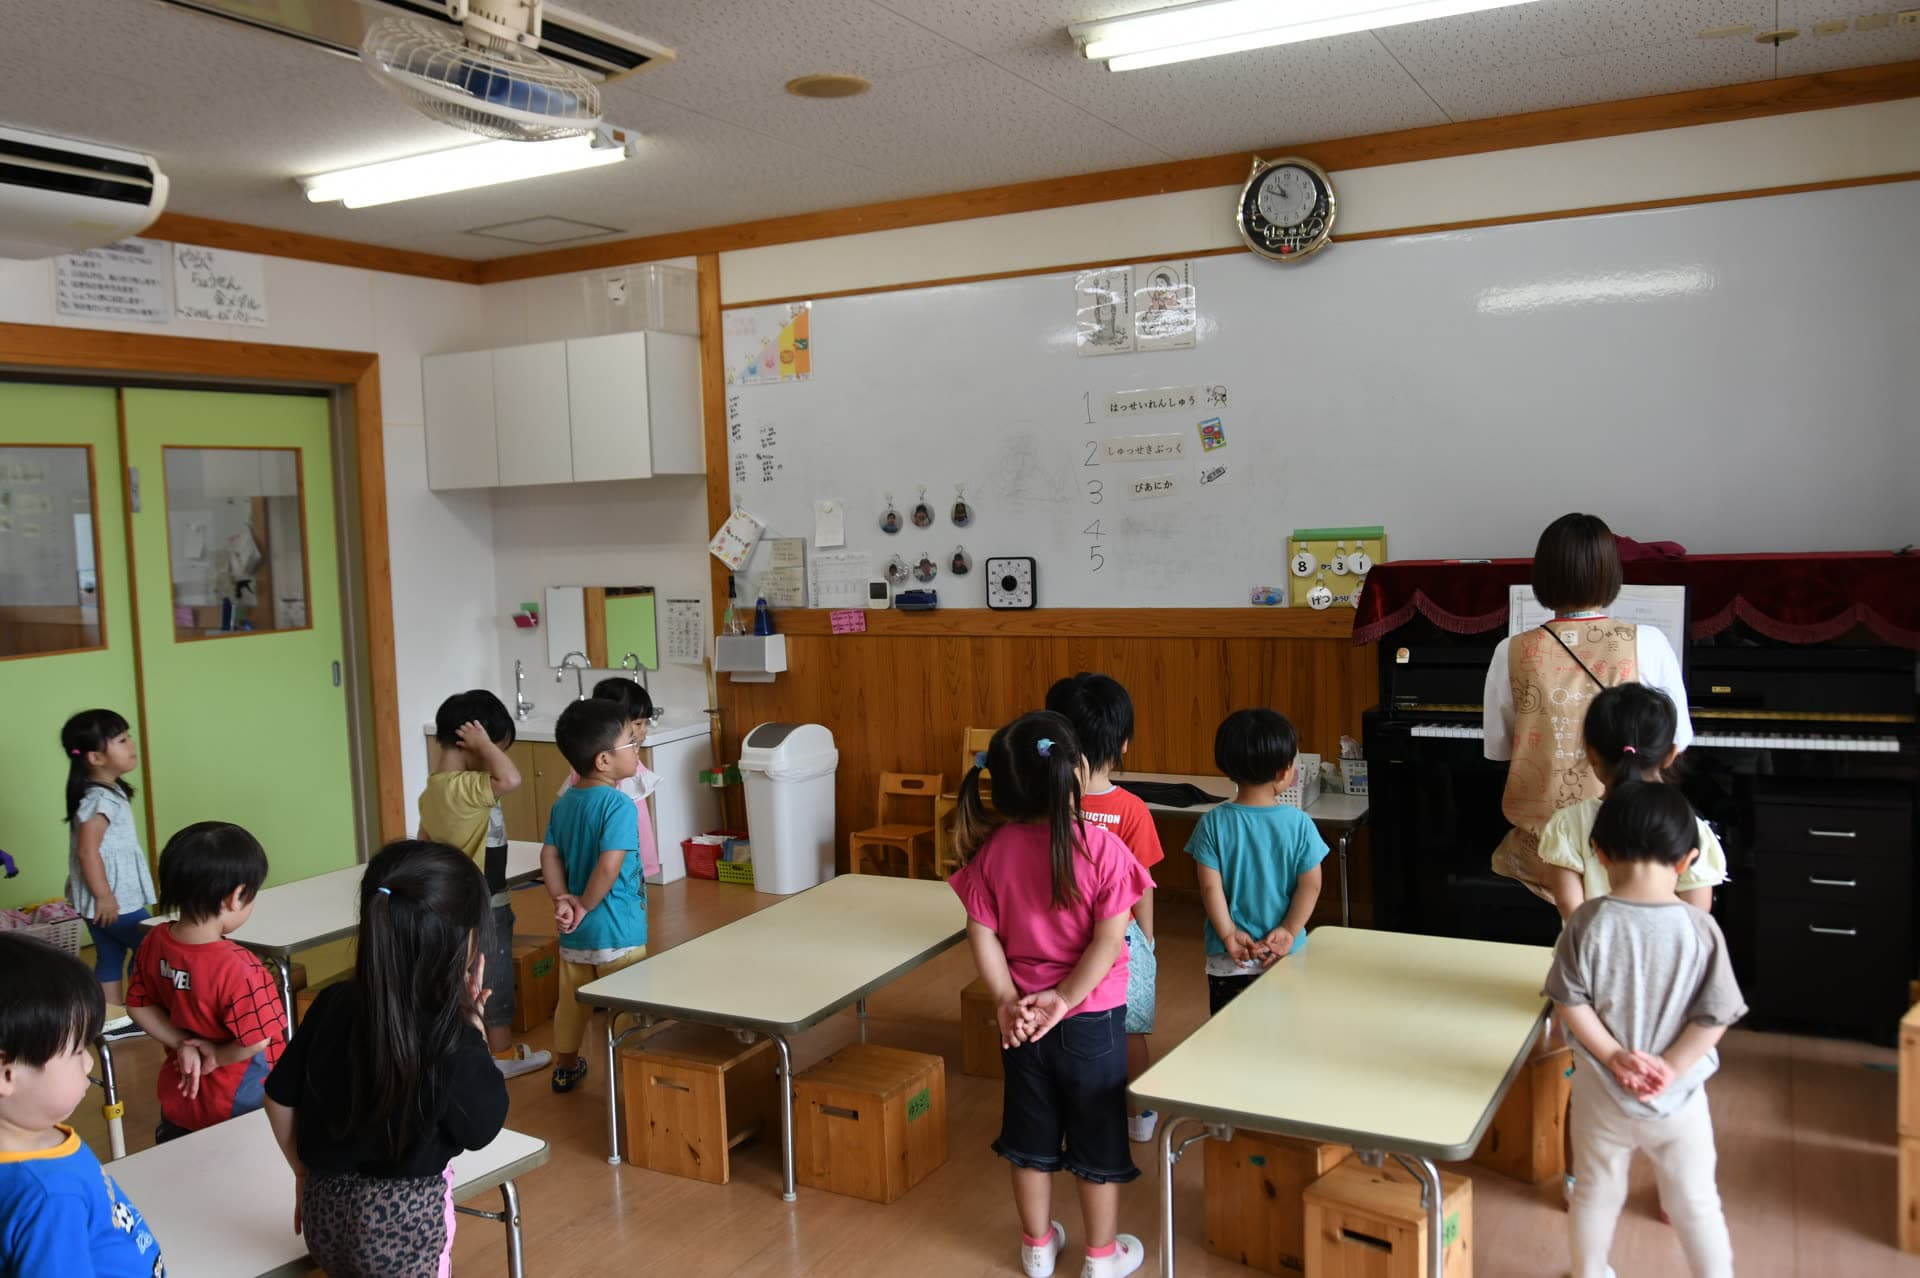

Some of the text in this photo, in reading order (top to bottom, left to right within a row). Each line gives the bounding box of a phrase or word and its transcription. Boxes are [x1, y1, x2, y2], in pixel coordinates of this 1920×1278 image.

[1083, 391, 1096, 424] 1
[1110, 395, 1197, 413] はっせいれんしゅう
[1084, 440, 1100, 467] 2
[1087, 479, 1104, 505] 3
[1083, 519, 1107, 540] 4
[1090, 545, 1105, 572] 5
[1298, 561, 1308, 573] 8
[1337, 562, 1344, 571] 3
